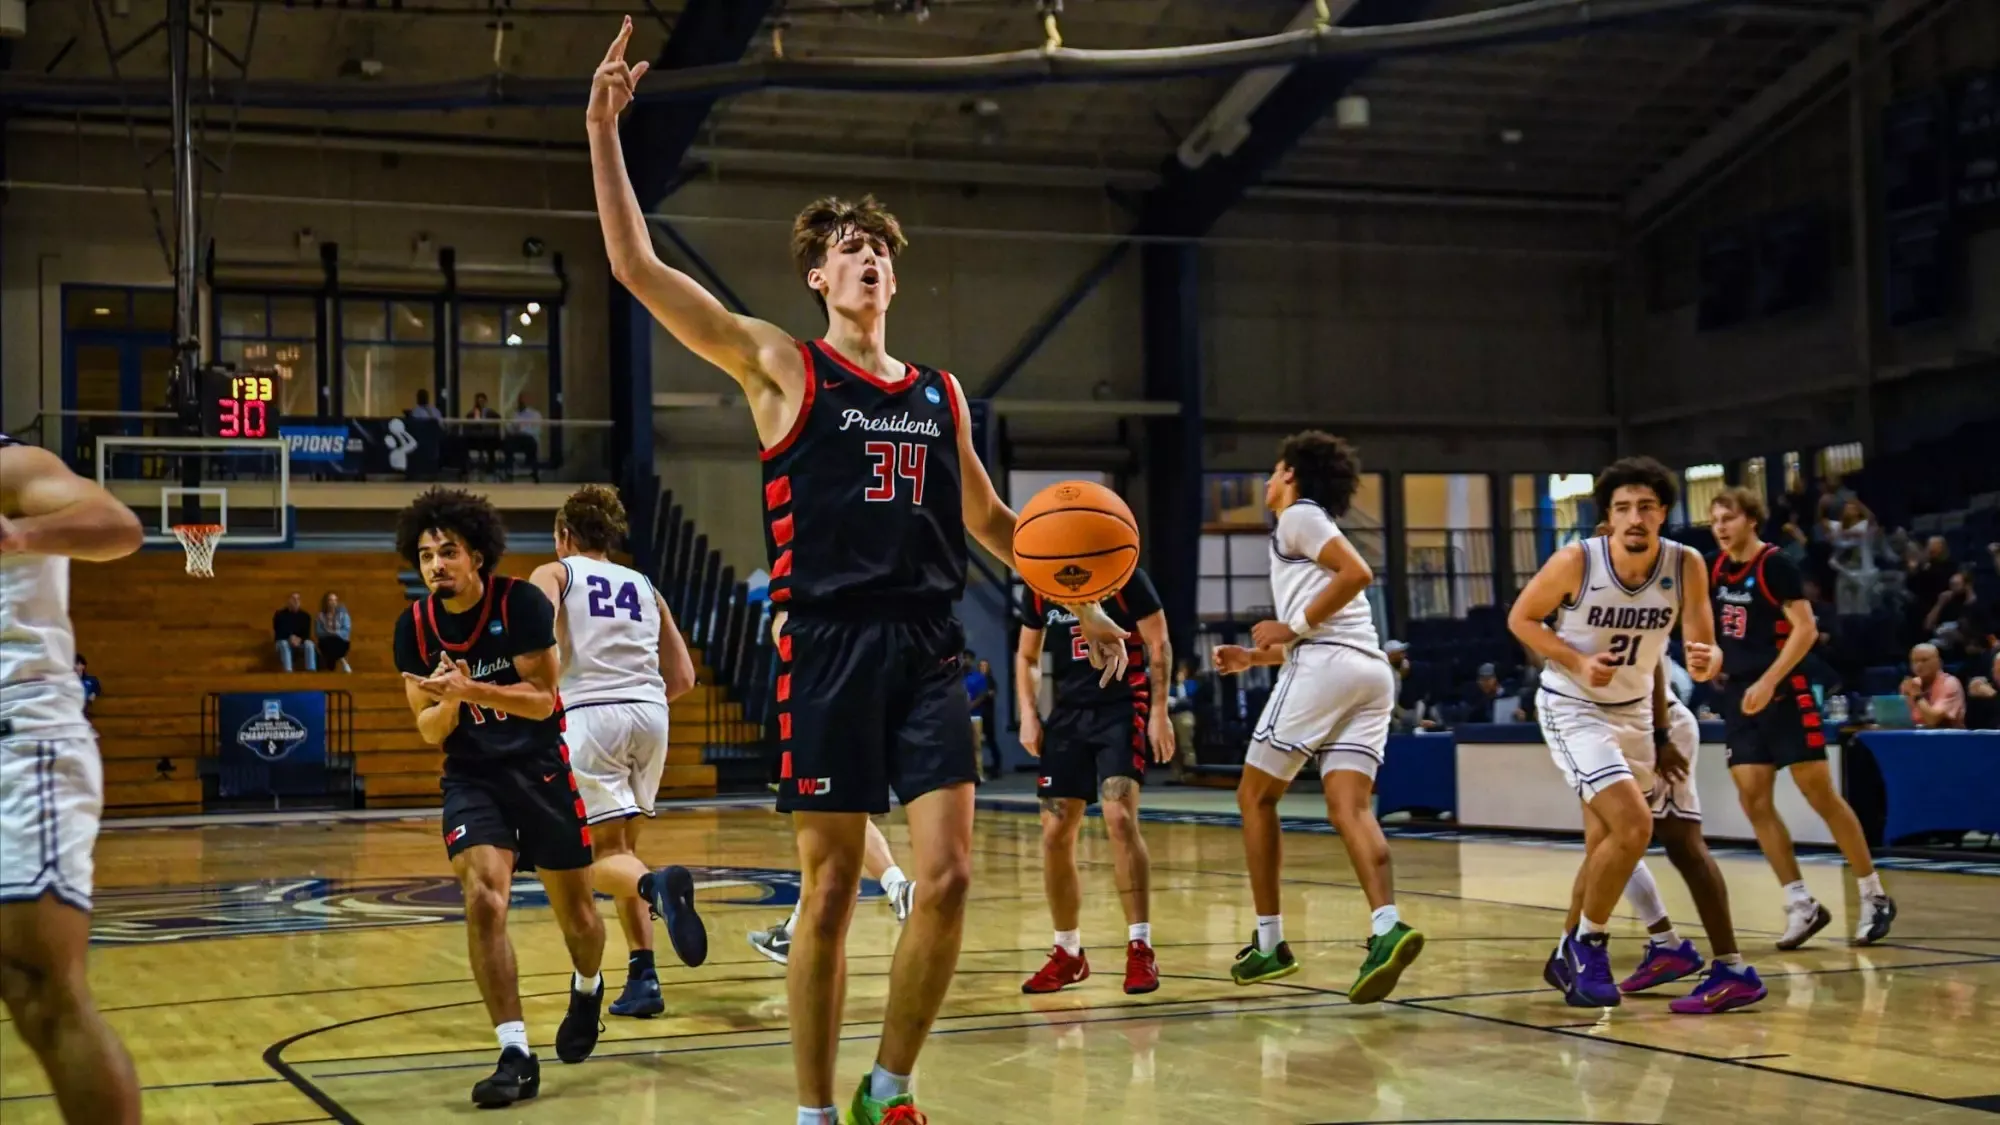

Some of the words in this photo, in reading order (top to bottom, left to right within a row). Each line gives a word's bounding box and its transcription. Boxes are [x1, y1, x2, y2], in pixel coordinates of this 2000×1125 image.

[219, 399, 266, 437] 30
[839, 408, 941, 437] Presidents
[279, 432, 345, 453] MPIONS
[865, 441, 927, 506] 34
[587, 574, 642, 622] 24
[1587, 606, 1673, 630] RAIDERS
[1608, 634, 1643, 667] 21
[471, 657, 511, 679] idents
[240, 730, 304, 741] CHAMPIONSHIP
